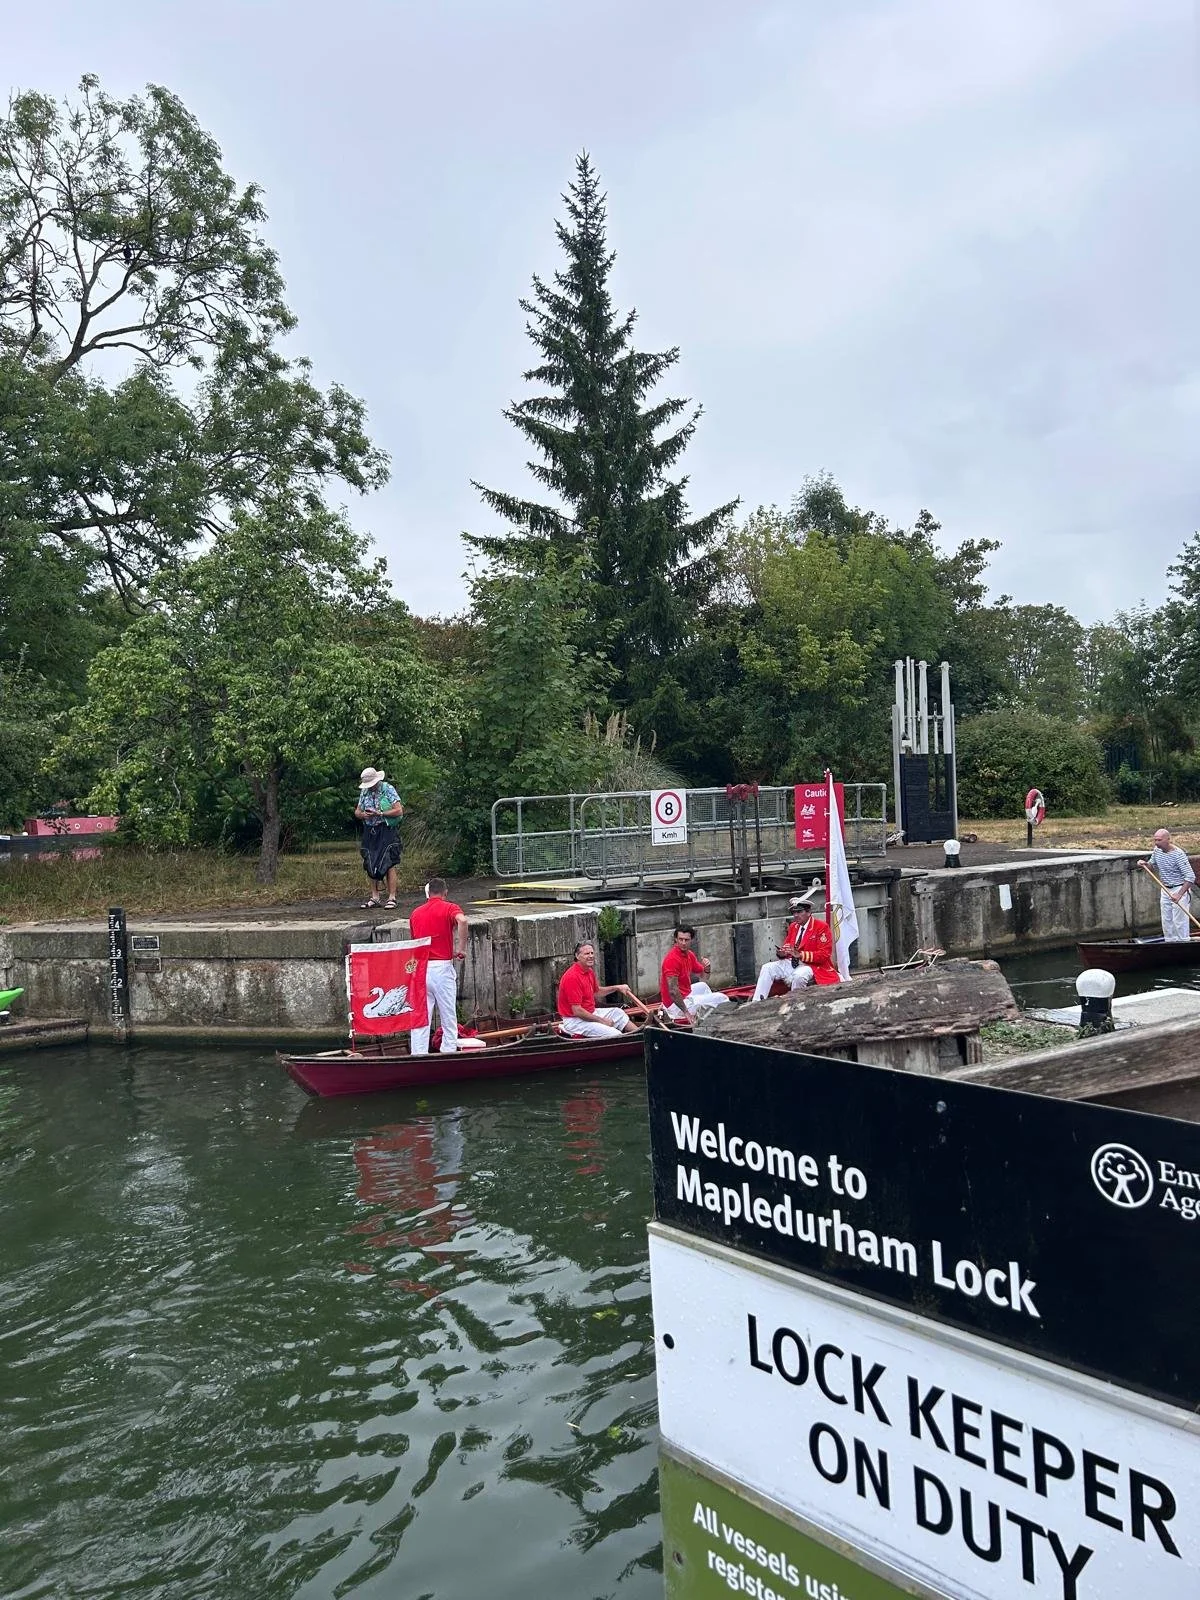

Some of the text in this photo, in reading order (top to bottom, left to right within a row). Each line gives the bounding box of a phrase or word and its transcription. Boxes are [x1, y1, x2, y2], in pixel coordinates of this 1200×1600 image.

[665, 802, 673, 815] 8
[804, 789, 827, 797] Cauti
[670, 1111, 868, 1200] Welcome to
[676, 1164, 1041, 1318] Mapledurham Lock
[747, 1313, 1182, 1559] LOCK KEEPER
[692, 1501, 848, 1600] All vessels usi
[808, 1422, 1094, 1600] ON DUTY
[707, 1549, 786, 1600] registe
